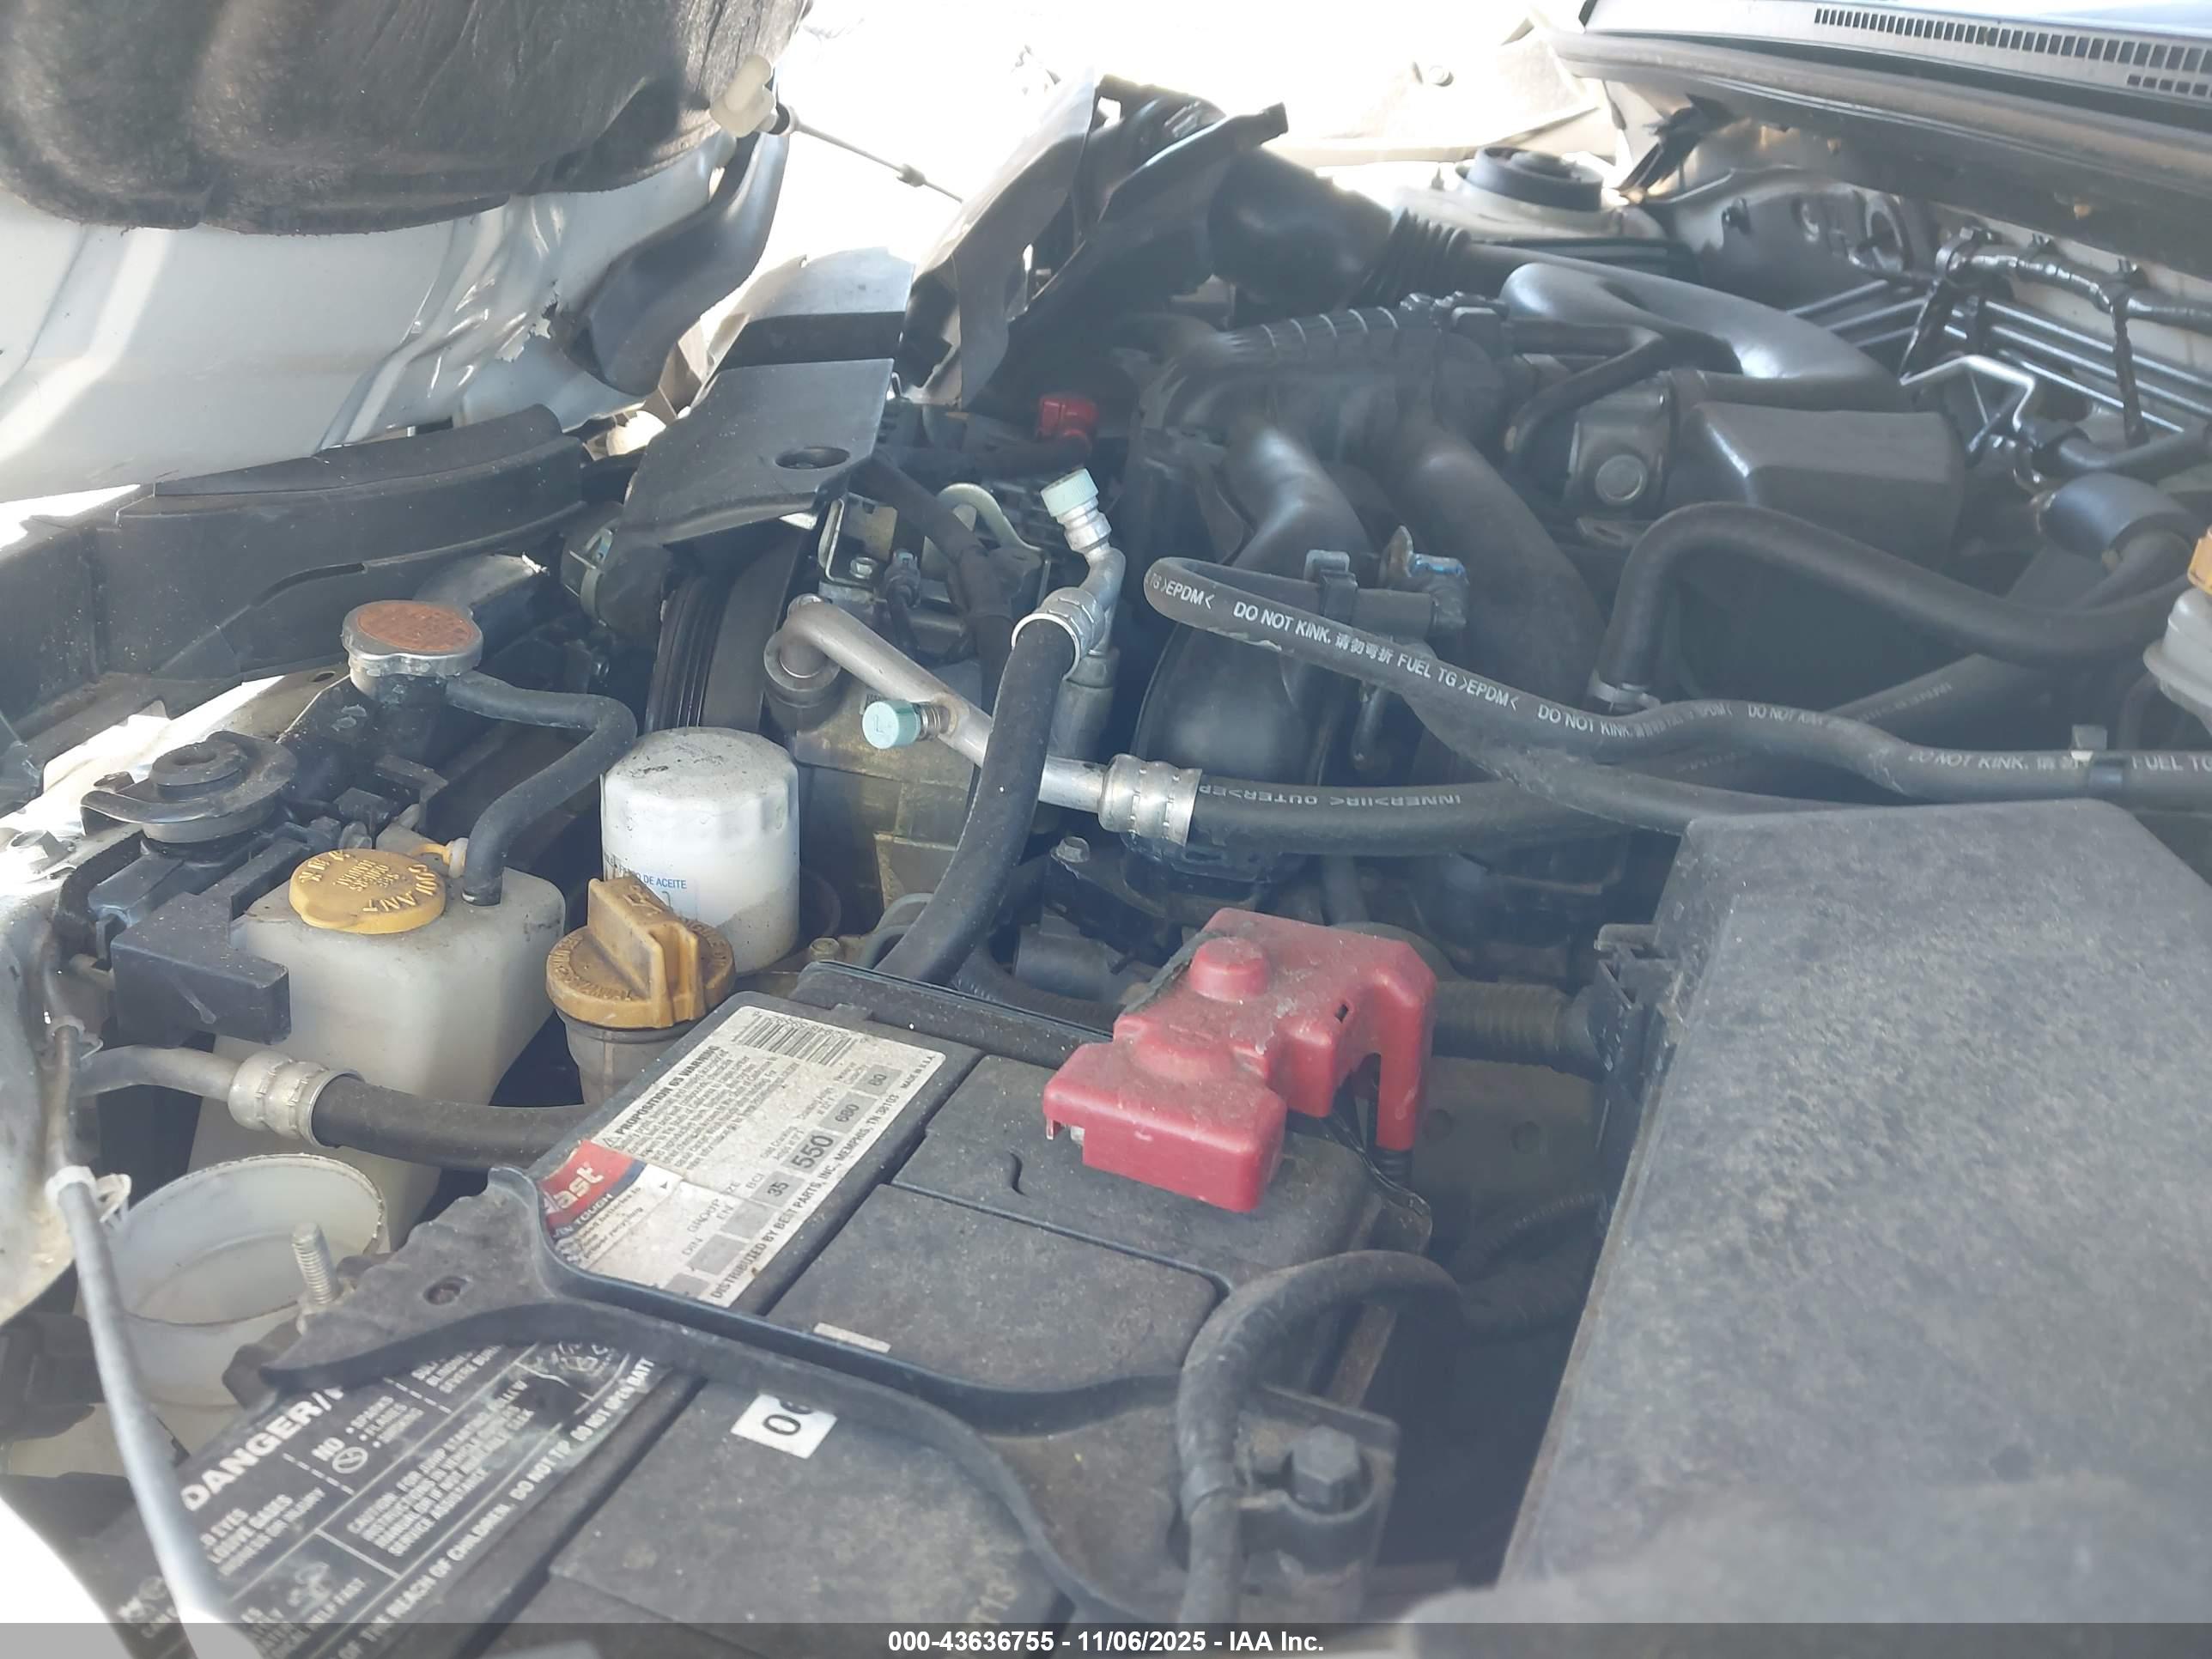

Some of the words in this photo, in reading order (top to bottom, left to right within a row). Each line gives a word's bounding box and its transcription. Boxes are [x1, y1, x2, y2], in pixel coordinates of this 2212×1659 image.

[1233, 601, 1258, 620] DO
[1261, 609, 1294, 631] NOT
[1295, 620, 1331, 643] KINK.
[1397, 653, 1431, 678] FUEL
[1437, 667, 1457, 687] TG
[1538, 704, 1561, 723] DO
[1565, 713, 1594, 732] NOT
[1747, 704, 1768, 720] DO
[1936, 753, 1972, 768] NOT
[1978, 755, 2029, 770] KINK.
[362, 864, 437, 912] COOLANT
[643, 874, 654, 885] DE
[656, 877, 687, 890] ACEITE
[613, 1085, 673, 1135] PROPOSITION
[667, 1075, 685, 1087] 65
[678, 1044, 720, 1077] WARNING
[763, 1177, 790, 1199] 35
[787, 1132, 836, 1170] 550
[709, 1239, 768, 1301] DISTRIBUTED
[760, 1228, 779, 1243] BY
[772, 1206, 799, 1231] BEST
[791, 1177, 827, 1210] PARTS,
[816, 1159, 842, 1182] INC.,
[832, 1123, 874, 1163] MEMPHIS,
[864, 1114, 882, 1126] TN
[898, 1073, 920, 1090] MADE
[573, 1189, 613, 1227] TOUGH
[607, 1205, 644, 1238] recycling
[680, 1236, 704, 1257] DIN
[715, 1204, 735, 1221] EN
[744, 1171, 766, 1189] BCI
[685, 1197, 723, 1234] GROUP
[434, 1363, 481, 1394] SEVERE
[346, 1395, 398, 1429] SPARKS
[360, 1401, 410, 1436] FLAMES
[580, 1407, 613, 1428] NOT
[307, 1435, 349, 1461] NO
[566, 1424, 596, 1442] DO
[393, 1469, 425, 1492] FOR
[414, 1447, 452, 1474] JUMP
[523, 1455, 562, 1483] NOT
[278, 1486, 331, 1524] INJURY
[358, 1477, 437, 1541] INSTRUCTIONS
[426, 1467, 448, 1481] IN
[505, 1479, 538, 1501] DO
[207, 1505, 252, 1538] EYES
[372, 1509, 422, 1549] MANUAL
[410, 1495, 437, 1514] OR
[434, 1469, 466, 1492] NOT
[385, 1516, 436, 1557] SERVICE
[425, 1556, 456, 1579] OF
[383, 1572, 439, 1620] REACH
